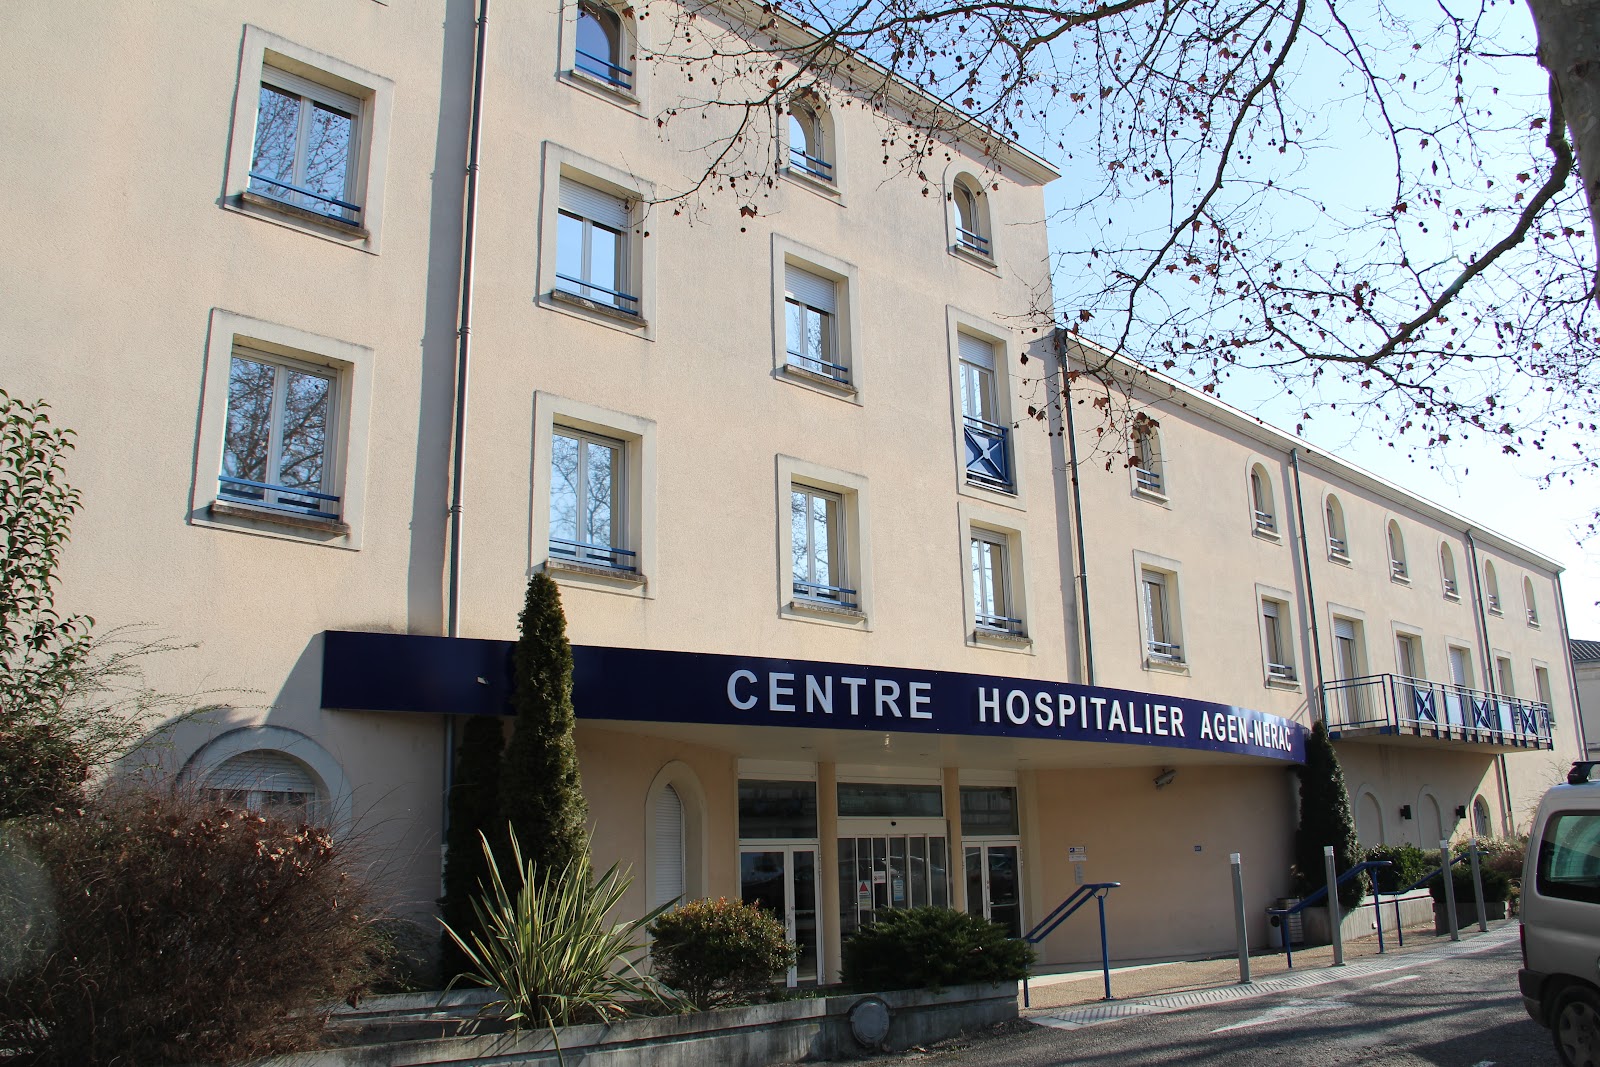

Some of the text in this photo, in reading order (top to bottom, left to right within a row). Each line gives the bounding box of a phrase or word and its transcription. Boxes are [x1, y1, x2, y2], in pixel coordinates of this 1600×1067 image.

[727, 669, 1292, 752] CENTRE HOSPITALIER AGEN-NERAC
